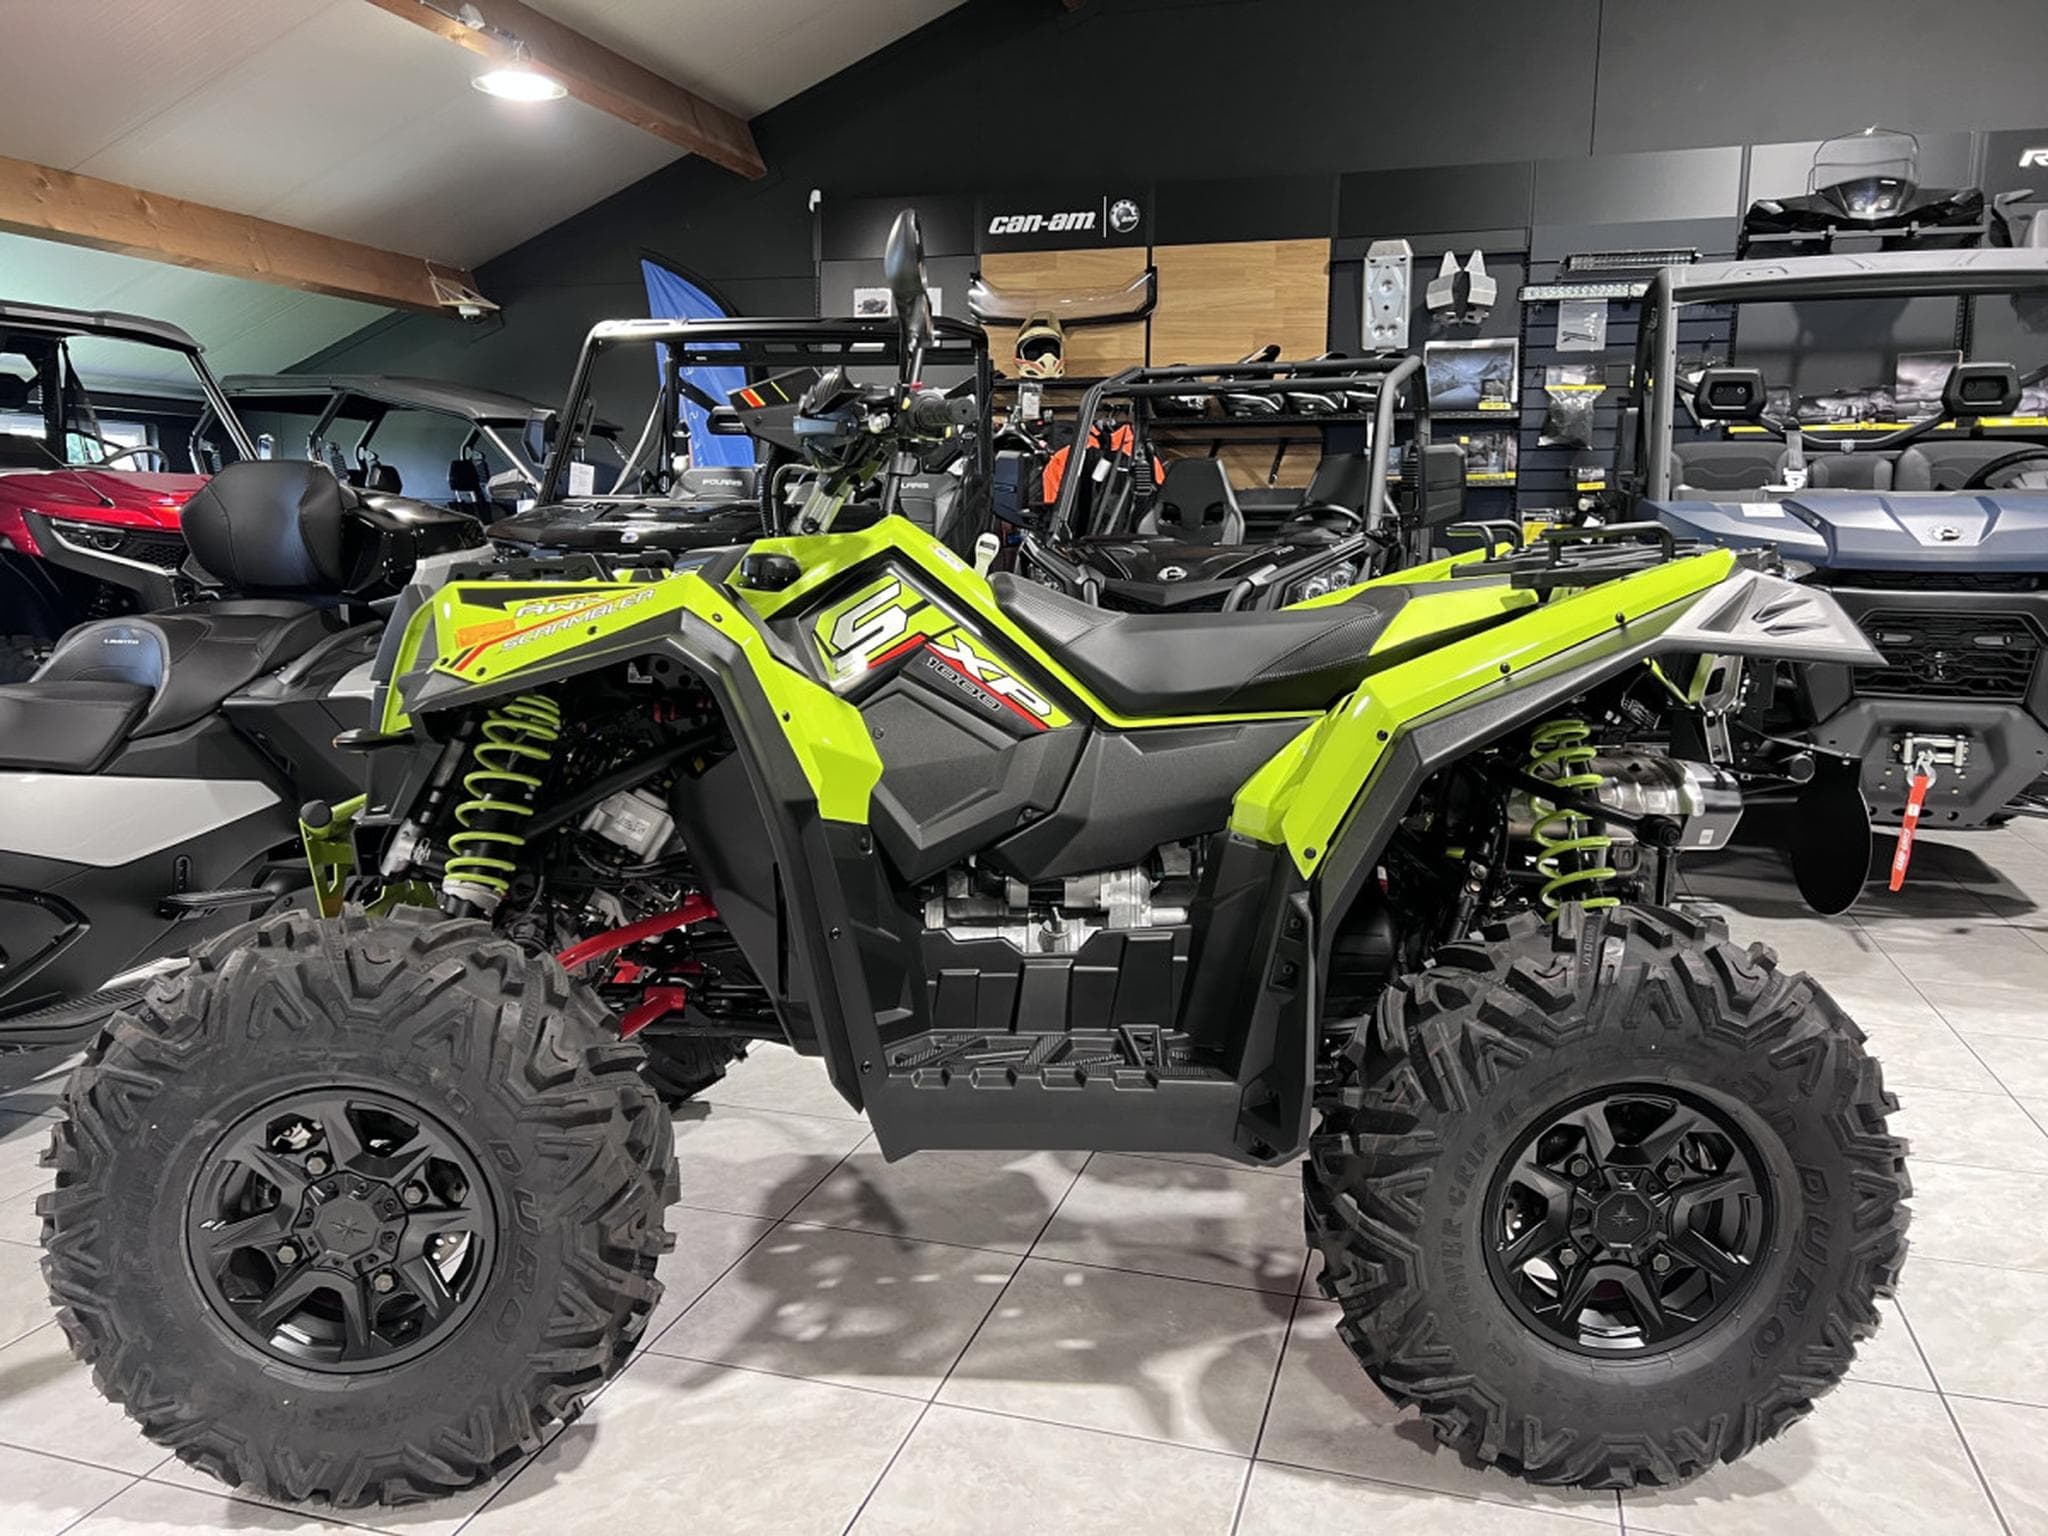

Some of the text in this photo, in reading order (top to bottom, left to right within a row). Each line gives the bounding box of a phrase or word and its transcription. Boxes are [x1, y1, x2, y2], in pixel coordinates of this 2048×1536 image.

[988, 211, 1096, 234] can-am
[501, 588, 655, 651] SCRAMBLER
[925, 634, 1051, 717] XP
[927, 656, 1002, 712] 1000
[487, 1139, 545, 1342] DURO
[1750, 1163, 1833, 1363] DURO
